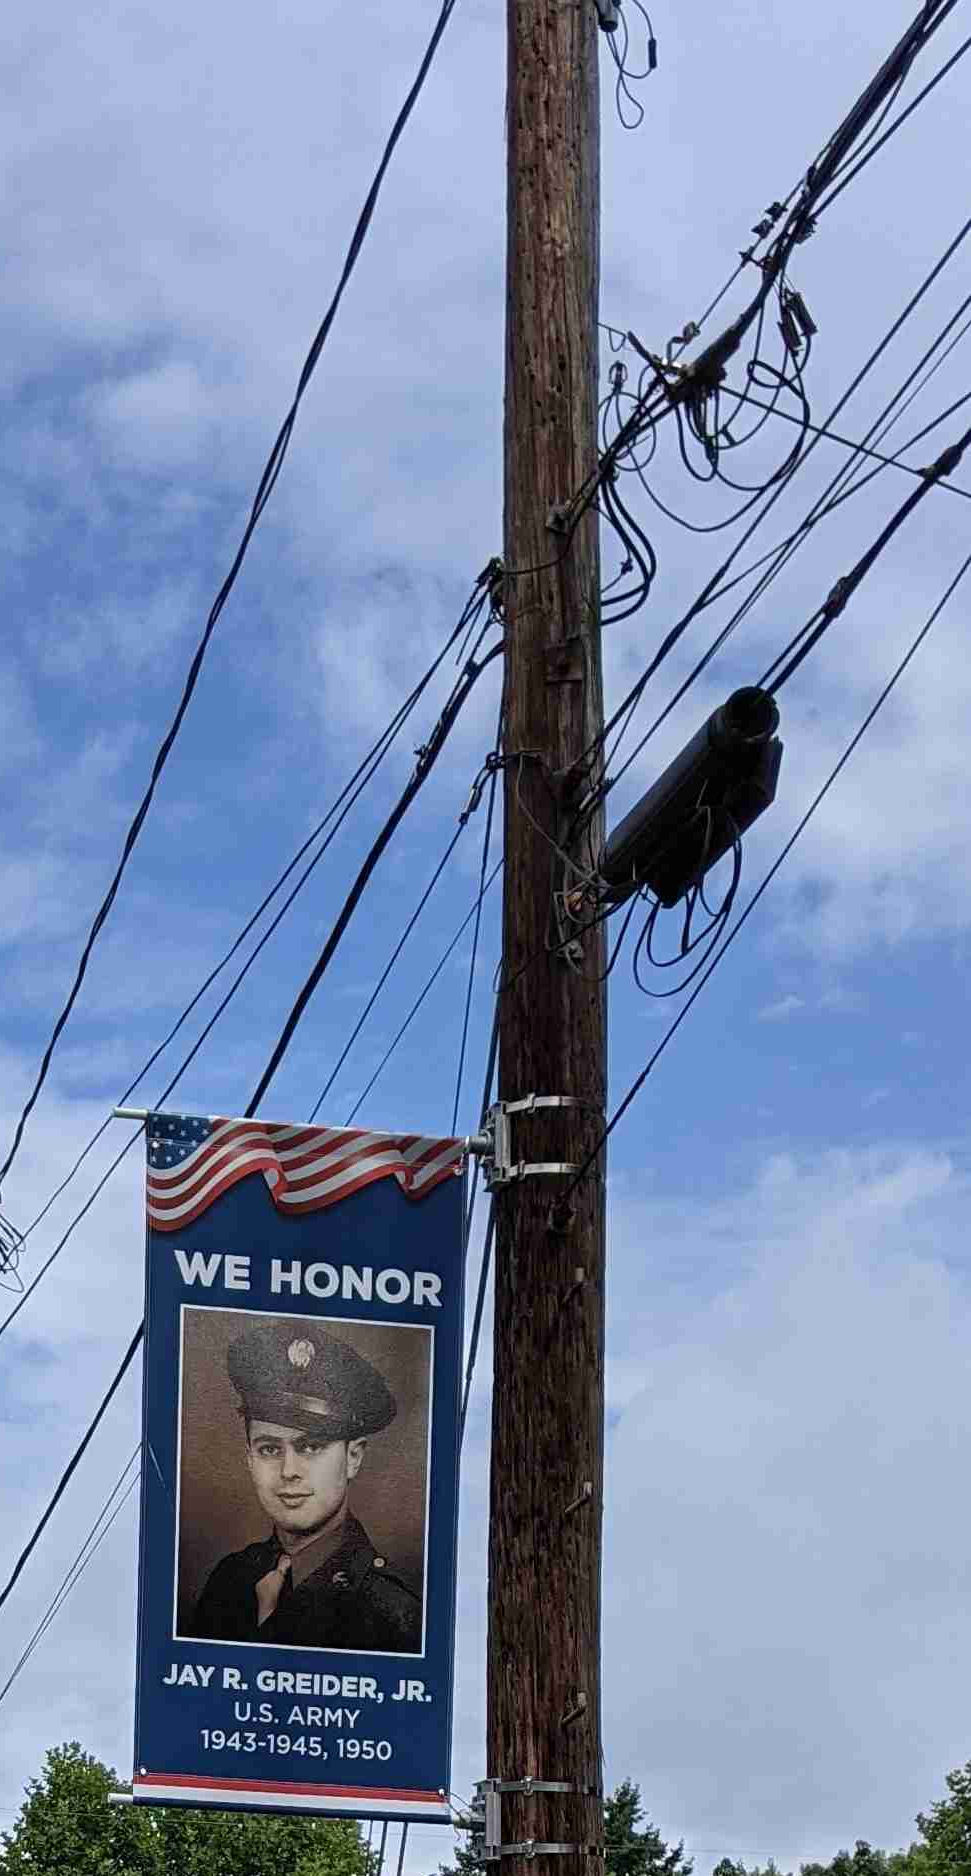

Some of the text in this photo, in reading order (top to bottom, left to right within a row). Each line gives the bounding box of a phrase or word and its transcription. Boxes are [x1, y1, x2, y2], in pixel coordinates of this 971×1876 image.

[173, 1249, 443, 1307] WE HONOR
[162, 1663, 432, 1703] JAY R. GREIDER, JR.
[234, 1701, 361, 1729] U.S. ARMY
[200, 1728, 393, 1761] 1943-1945, 1950
